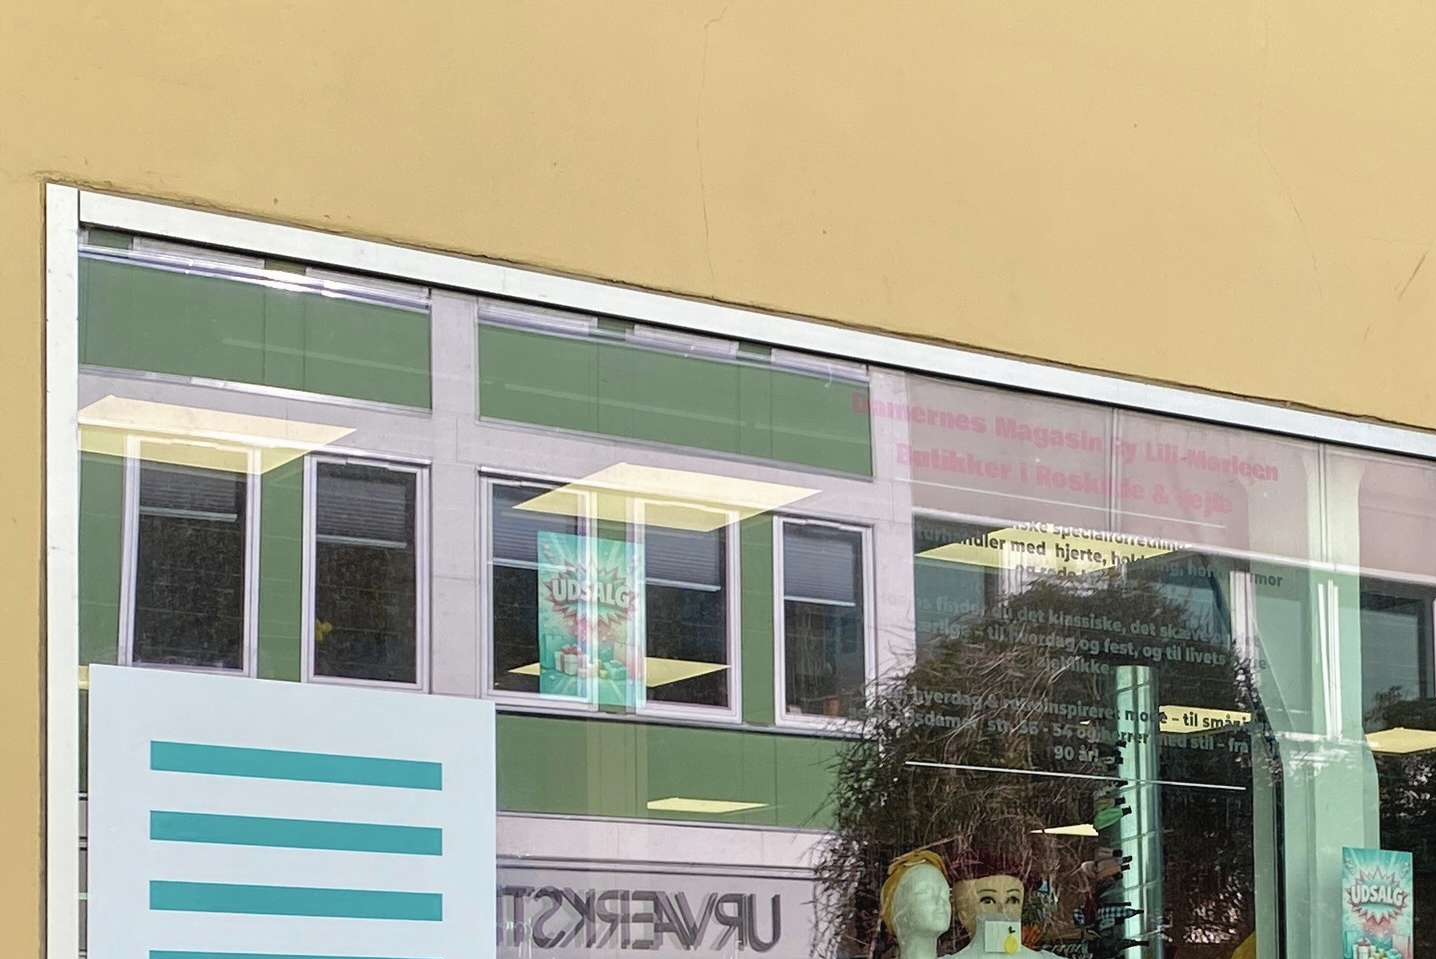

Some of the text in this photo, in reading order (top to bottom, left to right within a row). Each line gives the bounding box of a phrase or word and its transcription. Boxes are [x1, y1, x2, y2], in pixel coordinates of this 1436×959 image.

[896, 443, 1012, 480] Butikker
[995, 415, 1104, 450] Magasin
[1145, 442, 1279, 482] Lili-Marleen
[1011, 540, 1046, 557] med
[1055, 542, 1107, 566] hjerte,
[552, 578, 630, 608] UDSALG
[1050, 609, 1126, 636] klassiske,
[1131, 619, 1156, 637] det
[1080, 637, 1099, 655] og
[1104, 638, 1138, 658] fest,
[1142, 645, 1161, 662] og
[1166, 644, 1182, 661] til
[1186, 647, 1226, 666] livets
[1183, 711, 1198, 727] til
[1054, 745, 1075, 761] 90
[1350, 884, 1404, 906] UDSALG
